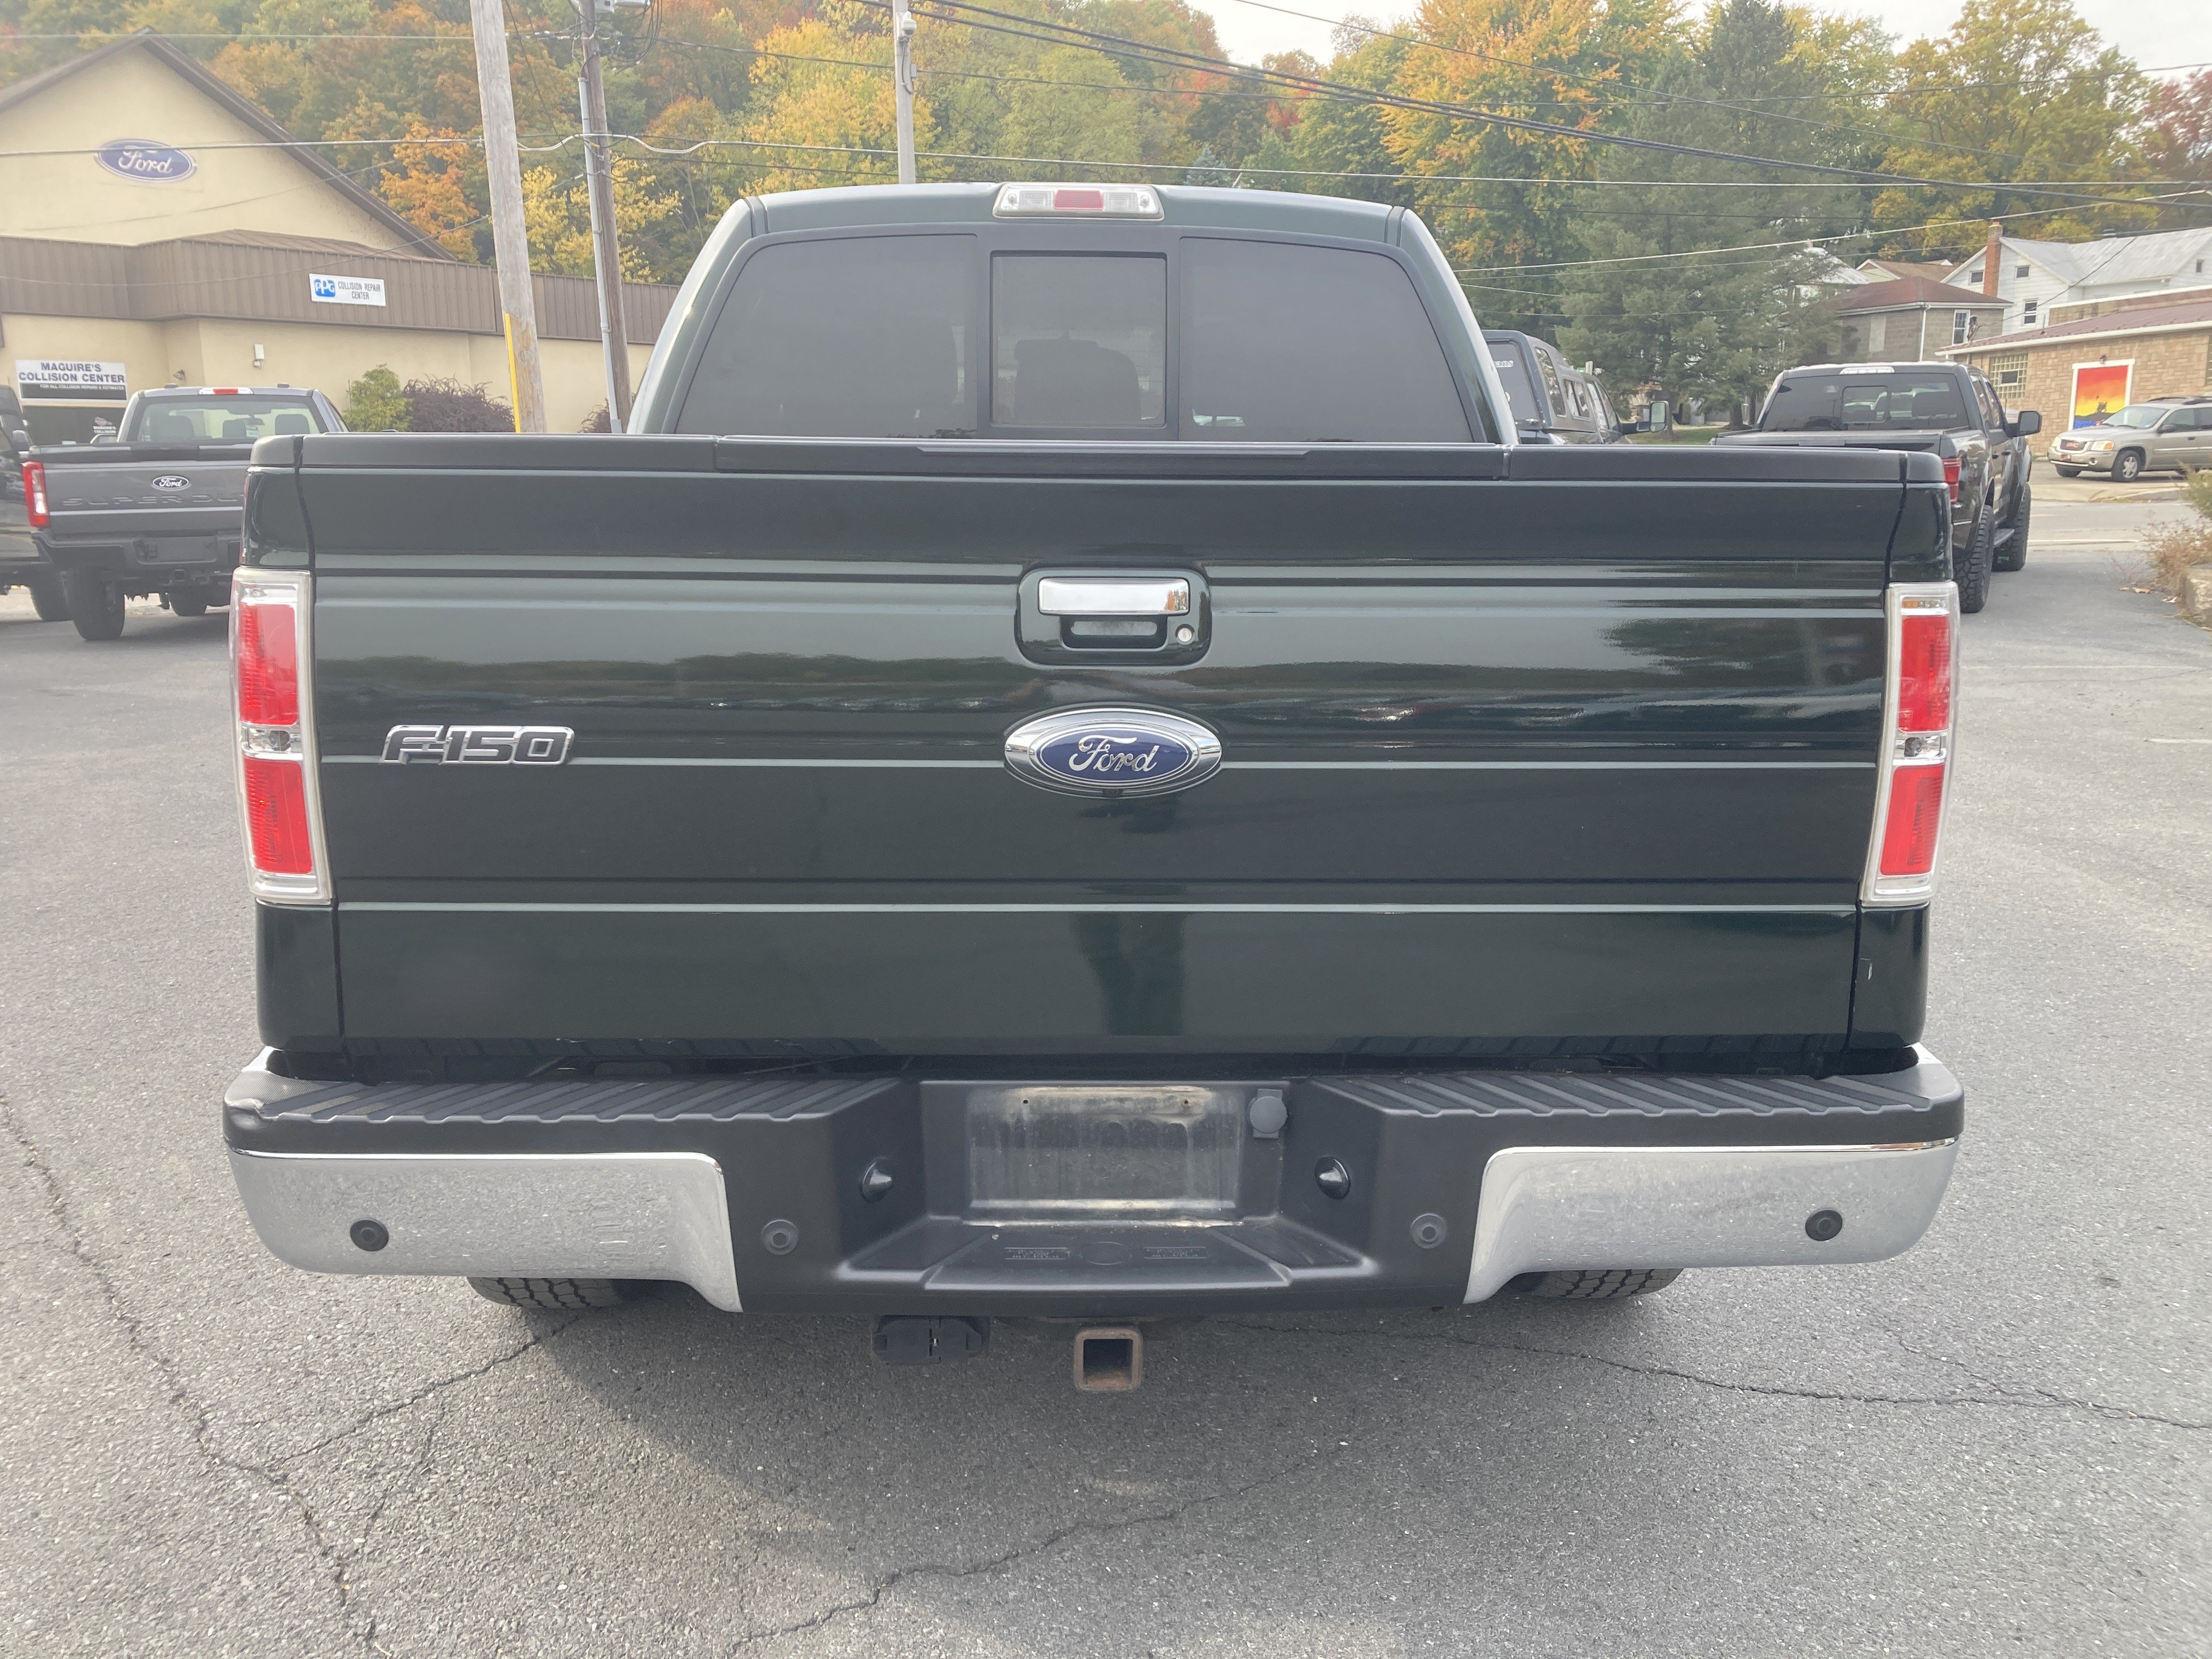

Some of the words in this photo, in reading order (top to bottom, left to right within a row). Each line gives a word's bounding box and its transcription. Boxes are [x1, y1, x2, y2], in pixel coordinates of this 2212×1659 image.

[118, 145, 172, 173] Ford
[315, 279, 335, 295] PPG
[337, 281, 363, 291] COLLISION
[364, 283, 381, 292] REPAIR
[351, 291, 370, 300] CENTER
[40, 362, 101, 373] MAGUIRE'S
[19, 372, 78, 382] COLLISION
[82, 374, 125, 383] CENTER
[159, 478, 182, 487] Ford
[1068, 734, 1160, 772] Ford
